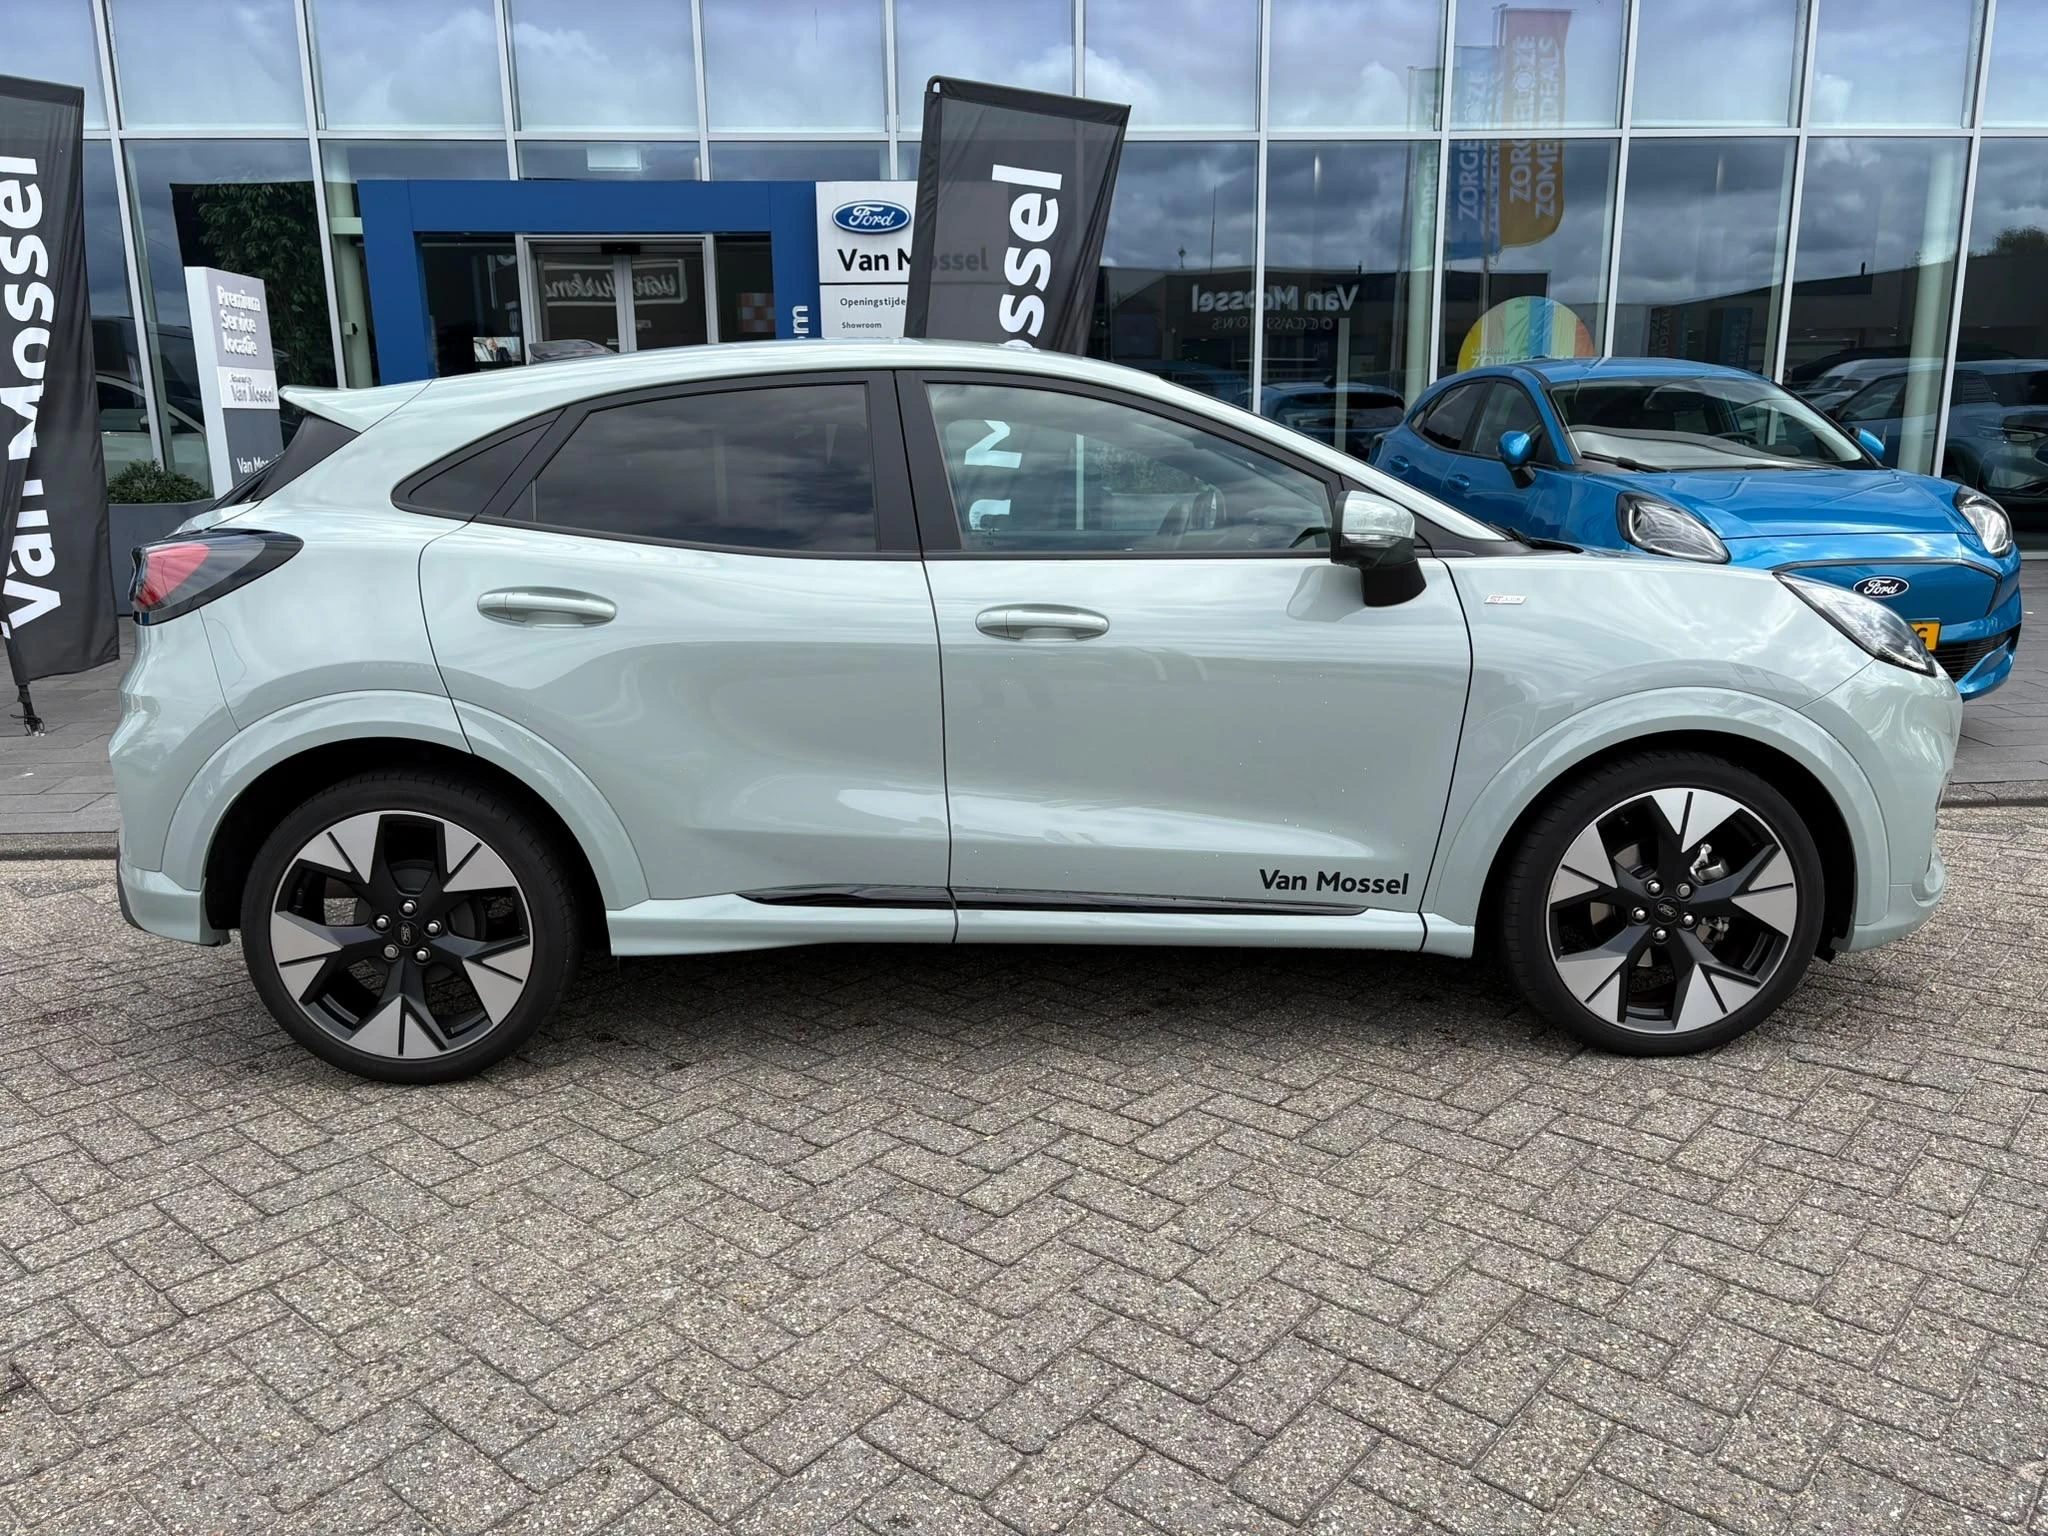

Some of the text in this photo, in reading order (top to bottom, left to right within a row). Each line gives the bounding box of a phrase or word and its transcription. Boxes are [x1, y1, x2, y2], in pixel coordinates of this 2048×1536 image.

[848, 205, 895, 227] Ford
[837, 248, 890, 272] Van
[840, 297, 907, 309] Openingstijde
[841, 321, 882, 330] Showroom
[236, 456, 254, 474] Van
[1863, 579, 1900, 595] Ford
[1259, 868, 1410, 895] Van Mossel
